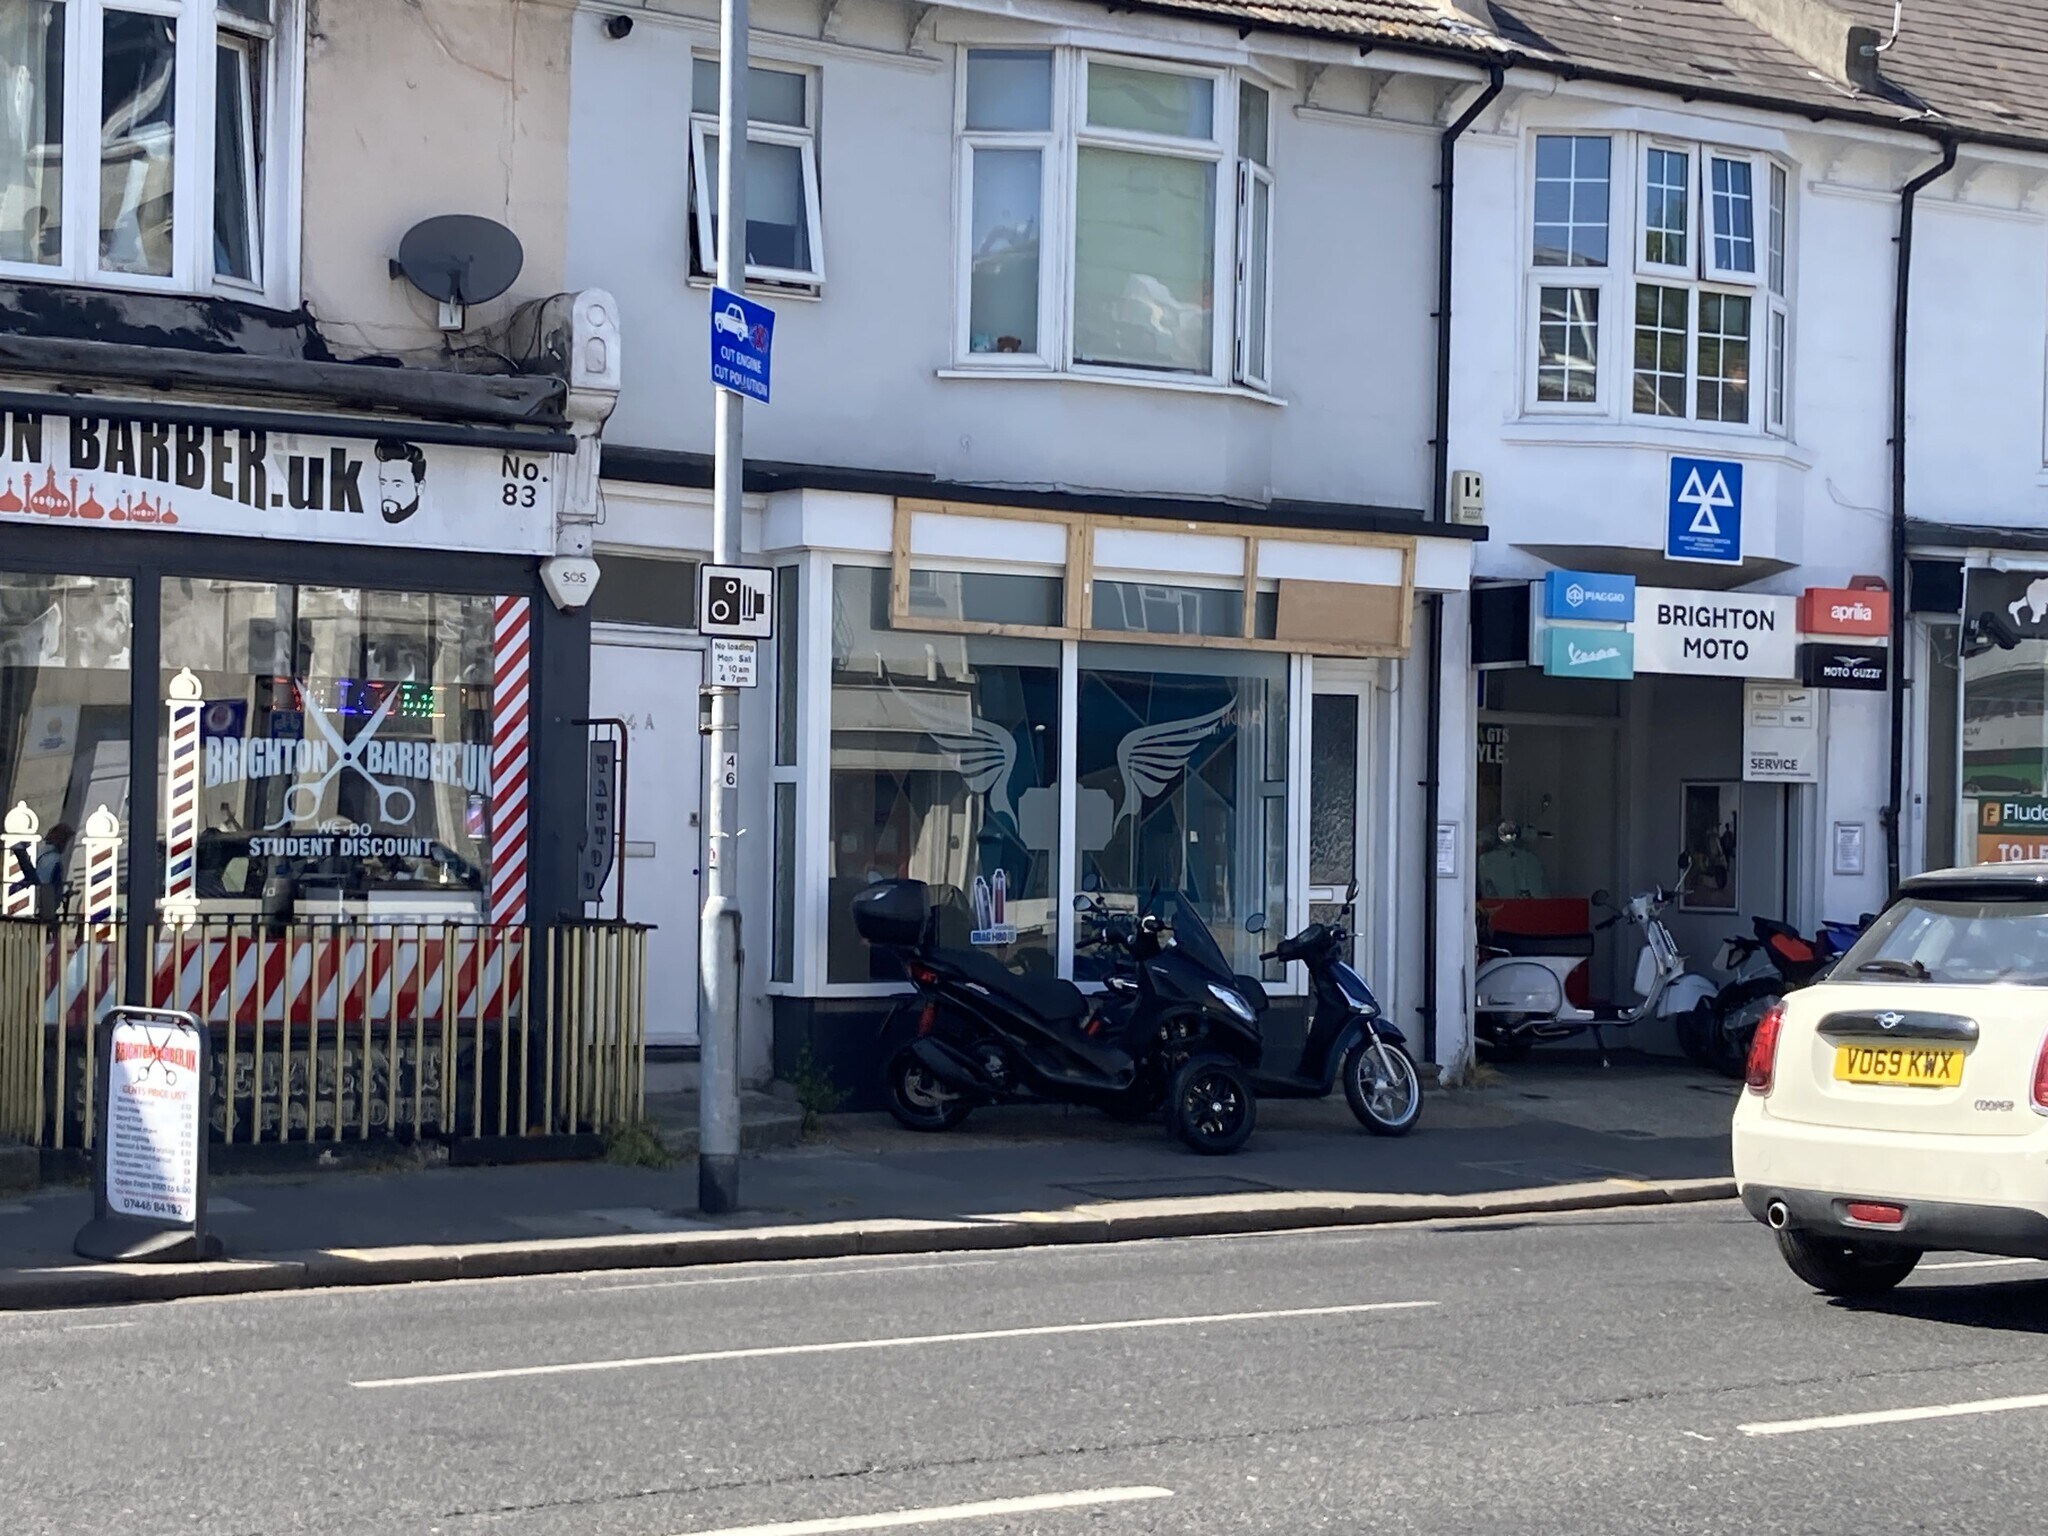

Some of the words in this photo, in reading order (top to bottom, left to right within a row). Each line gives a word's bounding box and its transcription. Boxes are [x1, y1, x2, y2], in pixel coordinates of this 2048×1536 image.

[721, 346, 735, 362] CUT
[736, 352, 762, 374] ENGINE
[714, 364, 729, 380] CUT
[729, 369, 768, 397] POLLUTION
[0, 408, 42, 463] N
[502, 455, 548, 482] No.
[502, 483, 536, 508] 83
[563, 572, 586, 583] SOS
[1585, 591, 1625, 602] PIAGGIO
[1658, 604, 1776, 631] BRIGHTON
[1831, 603, 1872, 622] aprilia
[715, 642, 726, 651] No
[727, 643, 754, 653] loading
[1568, 642, 1621, 665] Vespa
[1684, 638, 1749, 661] MOTO
[717, 654, 733, 662] Mon
[738, 654, 752, 663] Sat
[1823, 666, 1849, 678] MOTO
[1852, 668, 1882, 678] GUZZI
[205, 736, 328, 788] BRIGHTON
[367, 740, 493, 797] BARBER.UK
[726, 755, 735, 767] 4
[1750, 758, 1798, 770] SERVICE
[726, 772, 736, 785] 6
[249, 837, 335, 857] STUDENT
[339, 837, 433, 857] DISCOUNT
[1907, 1050, 1954, 1078] KWX
